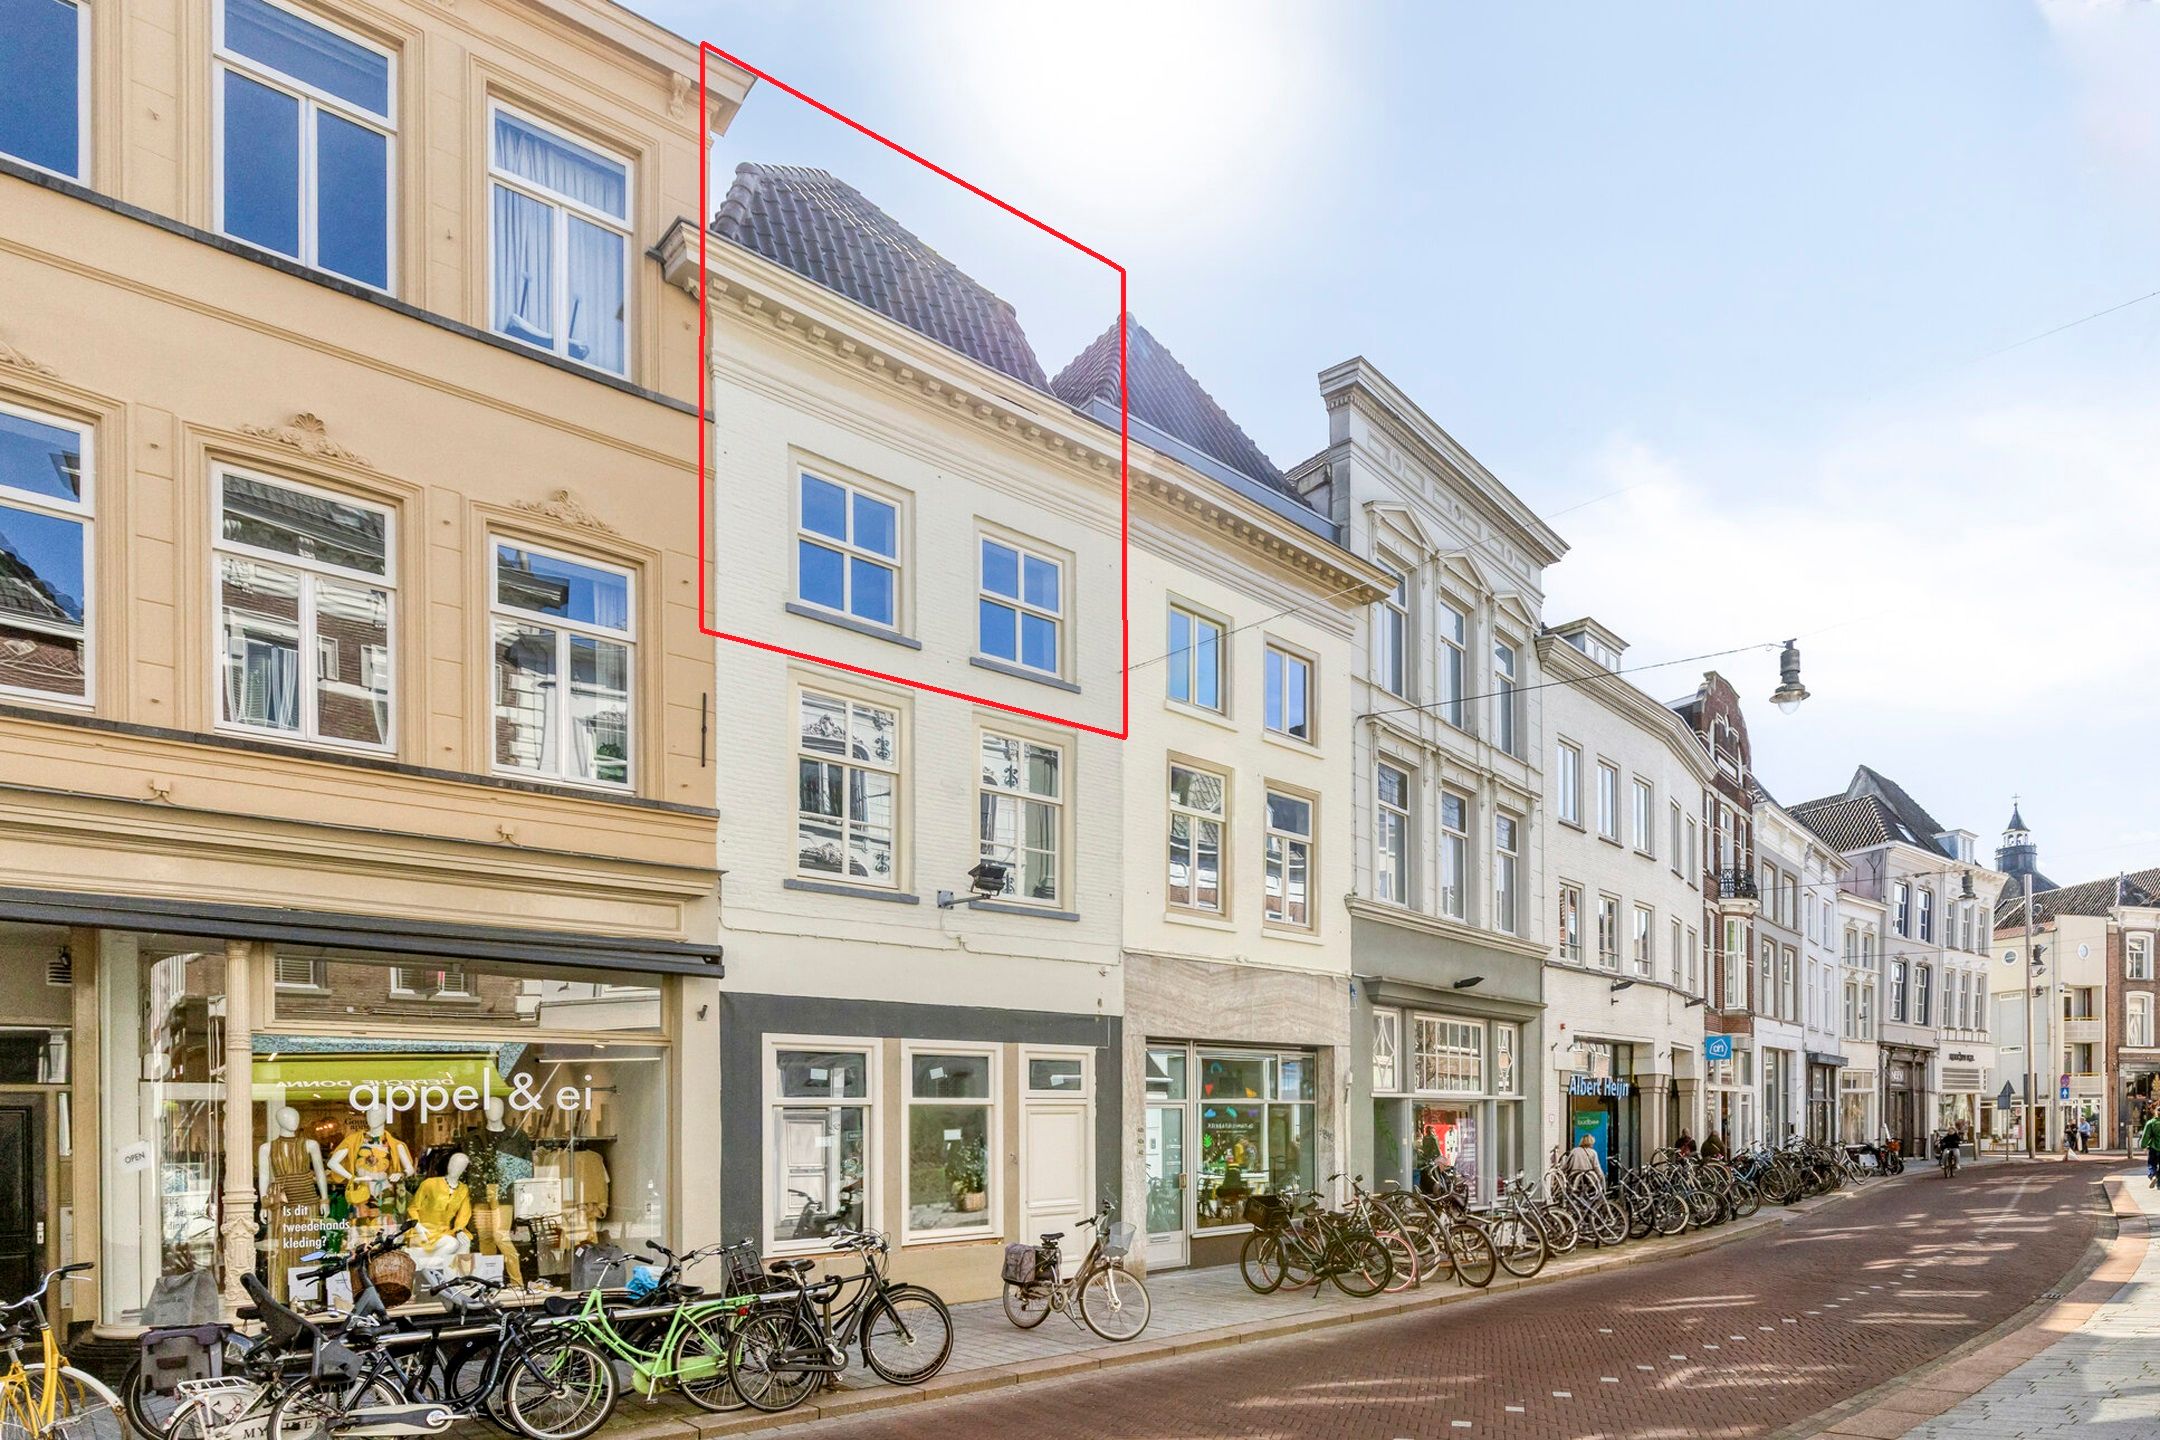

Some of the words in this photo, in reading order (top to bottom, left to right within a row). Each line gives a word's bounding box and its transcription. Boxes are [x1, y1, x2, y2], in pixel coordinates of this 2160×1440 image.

[1569, 1075, 1602, 1096] Albert
[1603, 1077, 1630, 1100] Heijn
[349, 1067, 490, 1124] appel
[508, 1072, 543, 1111] &
[556, 1074, 593, 1111] ei
[124, 1151, 145, 1164] OPEN
[282, 1205, 291, 1216] Is
[294, 1204, 308, 1216] dit
[282, 1218, 350, 1232] tweedehands
[282, 1236, 327, 1249] kleding?
